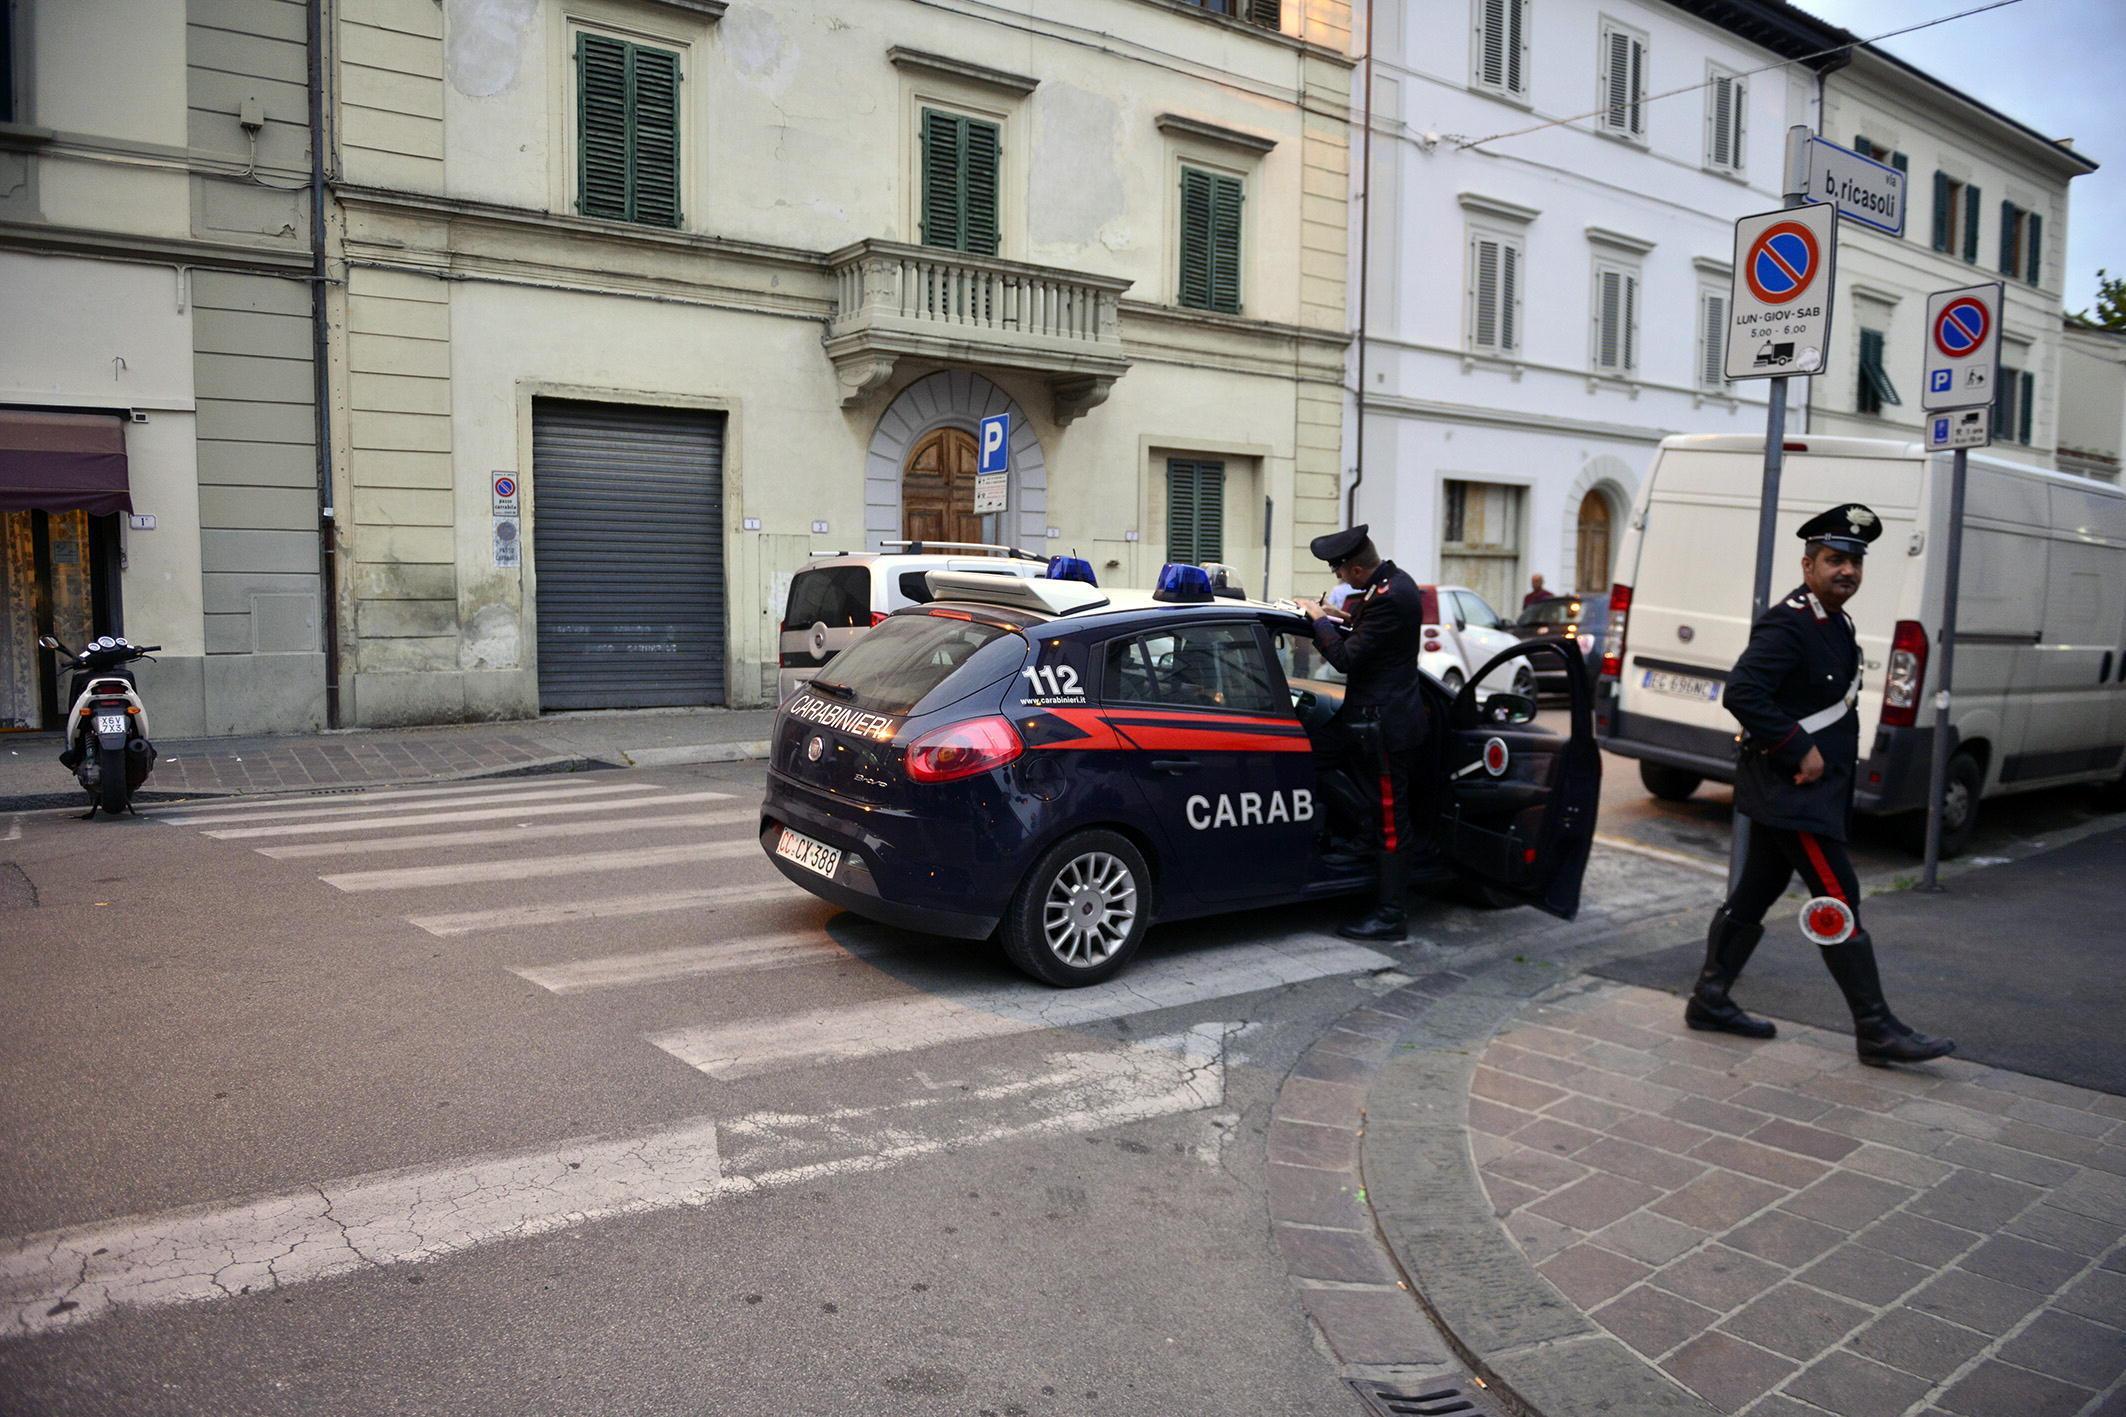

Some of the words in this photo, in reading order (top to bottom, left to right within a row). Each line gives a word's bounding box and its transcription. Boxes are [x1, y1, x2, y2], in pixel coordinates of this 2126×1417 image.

[1825, 168, 1896, 218] b.ricasoli
[1885, 174, 1897, 188] via
[1934, 371, 1949, 391] P
[982, 421, 1004, 469] P
[1021, 664, 1085, 696] 112
[1019, 695, 1087, 705] www.carabinieri.it
[790, 695, 893, 739] CARABINIERI
[1185, 788, 1315, 831] CARAB
[811, 844, 837, 873] 388
